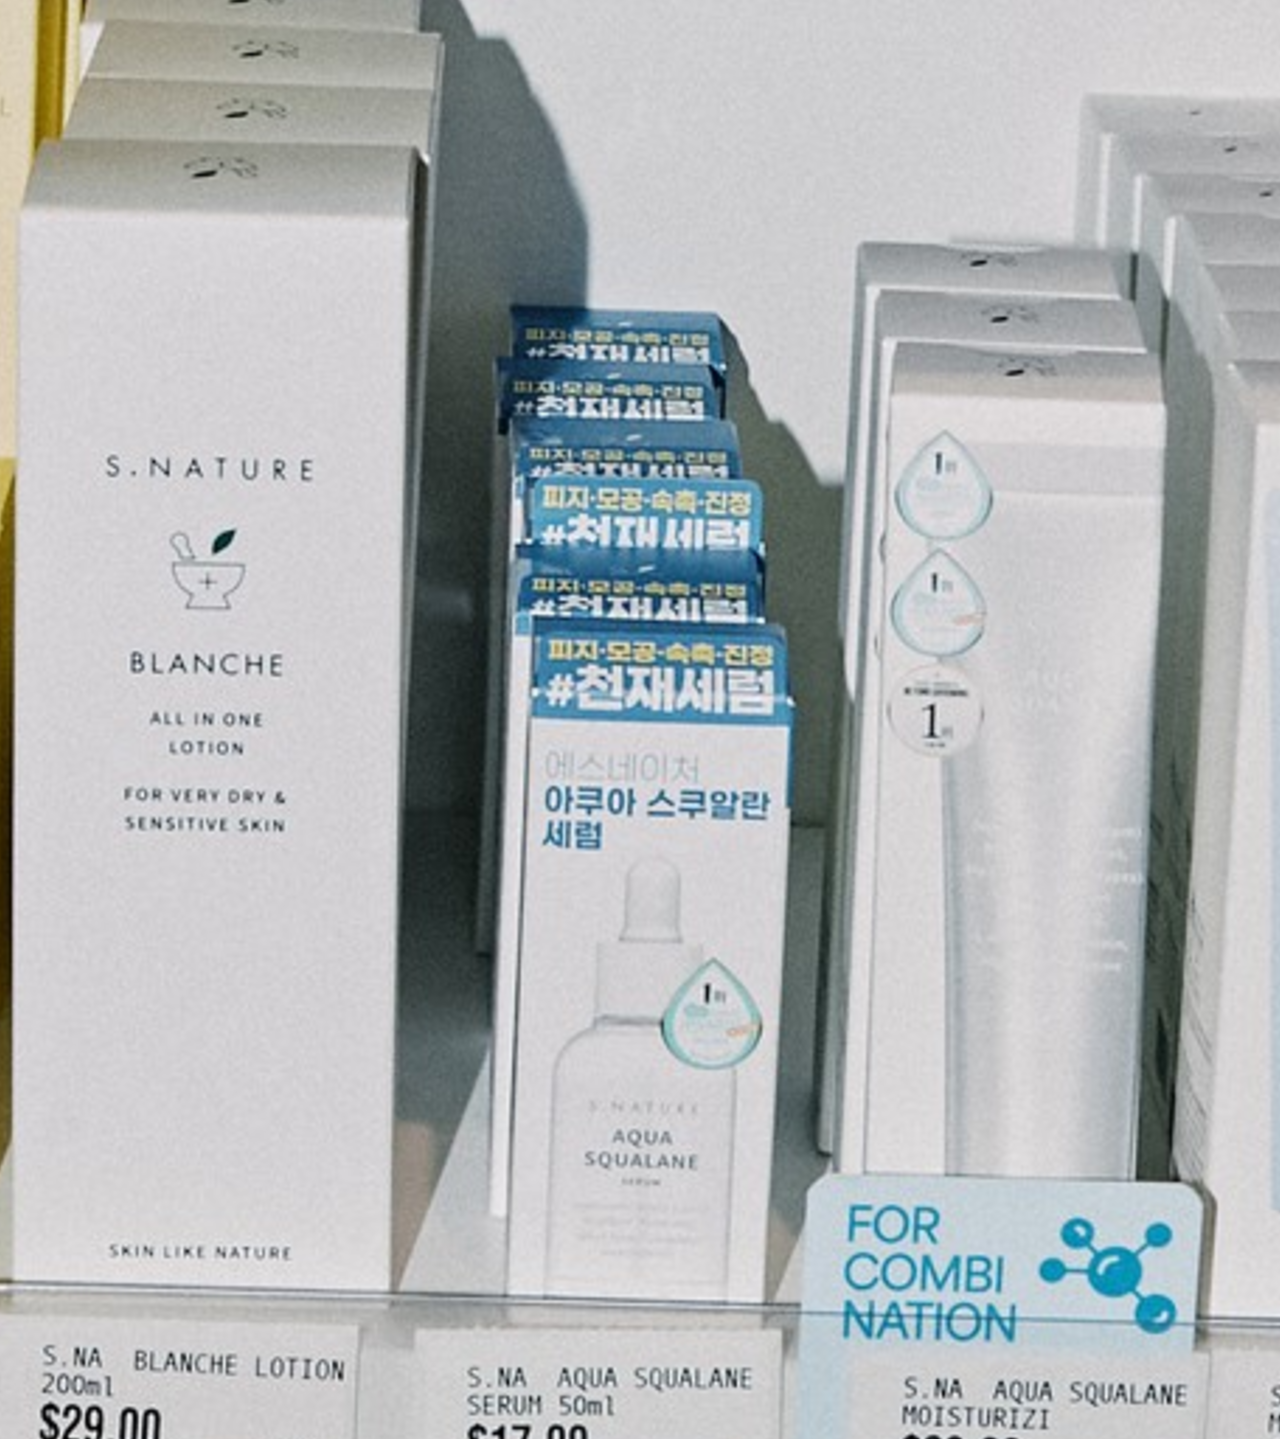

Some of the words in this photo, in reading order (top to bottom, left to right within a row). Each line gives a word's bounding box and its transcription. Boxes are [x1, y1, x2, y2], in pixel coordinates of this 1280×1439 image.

[105, 454, 315, 482] S.NATURE
[129, 651, 285, 678] BLANCHE
[547, 665, 775, 717] #천재세럼
[149, 711, 185, 727] ALL
[194, 712, 215, 727] IN
[222, 713, 264, 728] ONE
[169, 740, 245, 756] LOTION
[124, 786, 162, 802] FOR
[170, 788, 220, 803] VERY
[228, 788, 265, 804] DRY
[274, 791, 287, 805] &
[545, 785, 636, 817] 아쿠아
[646, 787, 770, 821] 스쿠알란
[124, 816, 229, 832] SENSITIVE
[238, 818, 286, 833] SKIN
[542, 820, 604, 851] 세럼
[612, 1128, 674, 1149] AQUA
[583, 1150, 700, 1171] SQUALANE
[847, 1204, 940, 1245] FOR
[843, 1252, 1005, 1294] COMBI
[842, 1299, 1017, 1342] NATION
[42, 1344, 103, 1369] S.NA
[133, 1349, 238, 1377] BLANCHE
[255, 1356, 346, 1381] LOTION
[41, 1373, 114, 1397] 200ml
[467, 1367, 527, 1389] S.NA
[557, 1367, 618, 1393] AQUA
[634, 1367, 753, 1393] SQUALANE
[903, 1376, 963, 1399] S.NA
[992, 1379, 1054, 1404] AQUA
[1069, 1381, 1188, 1407] SQUALANE
[467, 1394, 543, 1417] SERUM
[558, 1394, 616, 1417] 50ml
[902, 1405, 1050, 1430] MOISTURIZI
